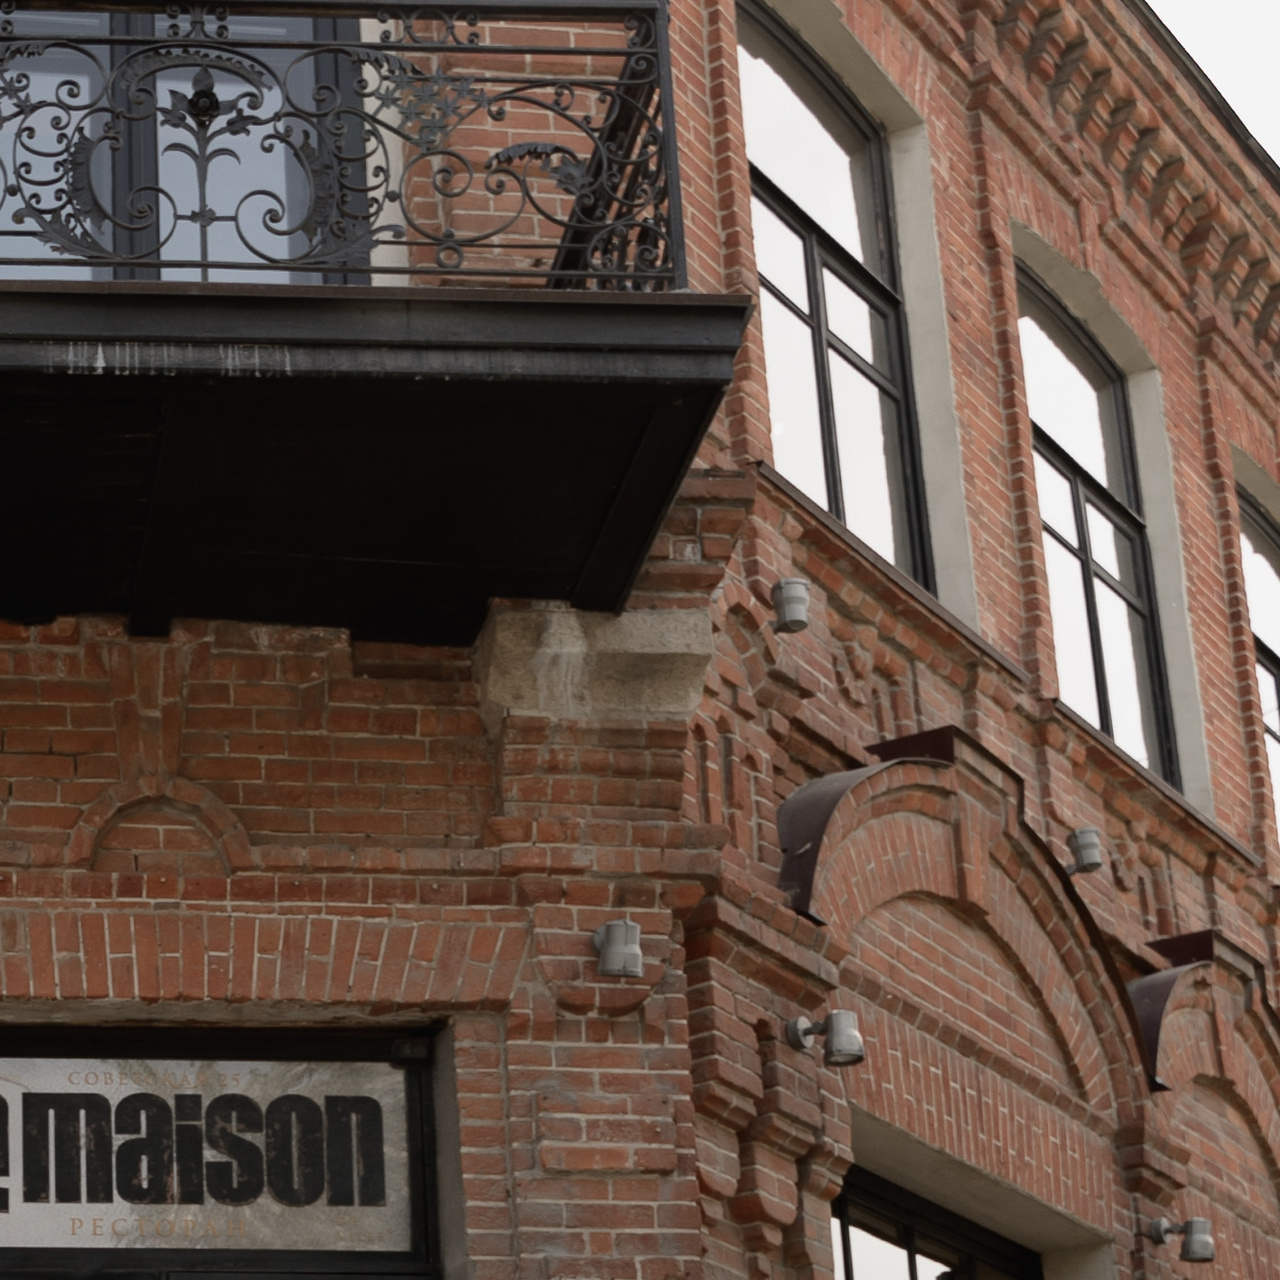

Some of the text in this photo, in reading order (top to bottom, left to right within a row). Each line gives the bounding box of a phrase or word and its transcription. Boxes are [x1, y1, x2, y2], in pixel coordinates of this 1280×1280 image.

[67, 1071, 241, 1089] СОВЕТСКАЯ 25
[22, 1092, 387, 1207] maison
[69, 1217, 247, 1238] РЕСТОРАН
